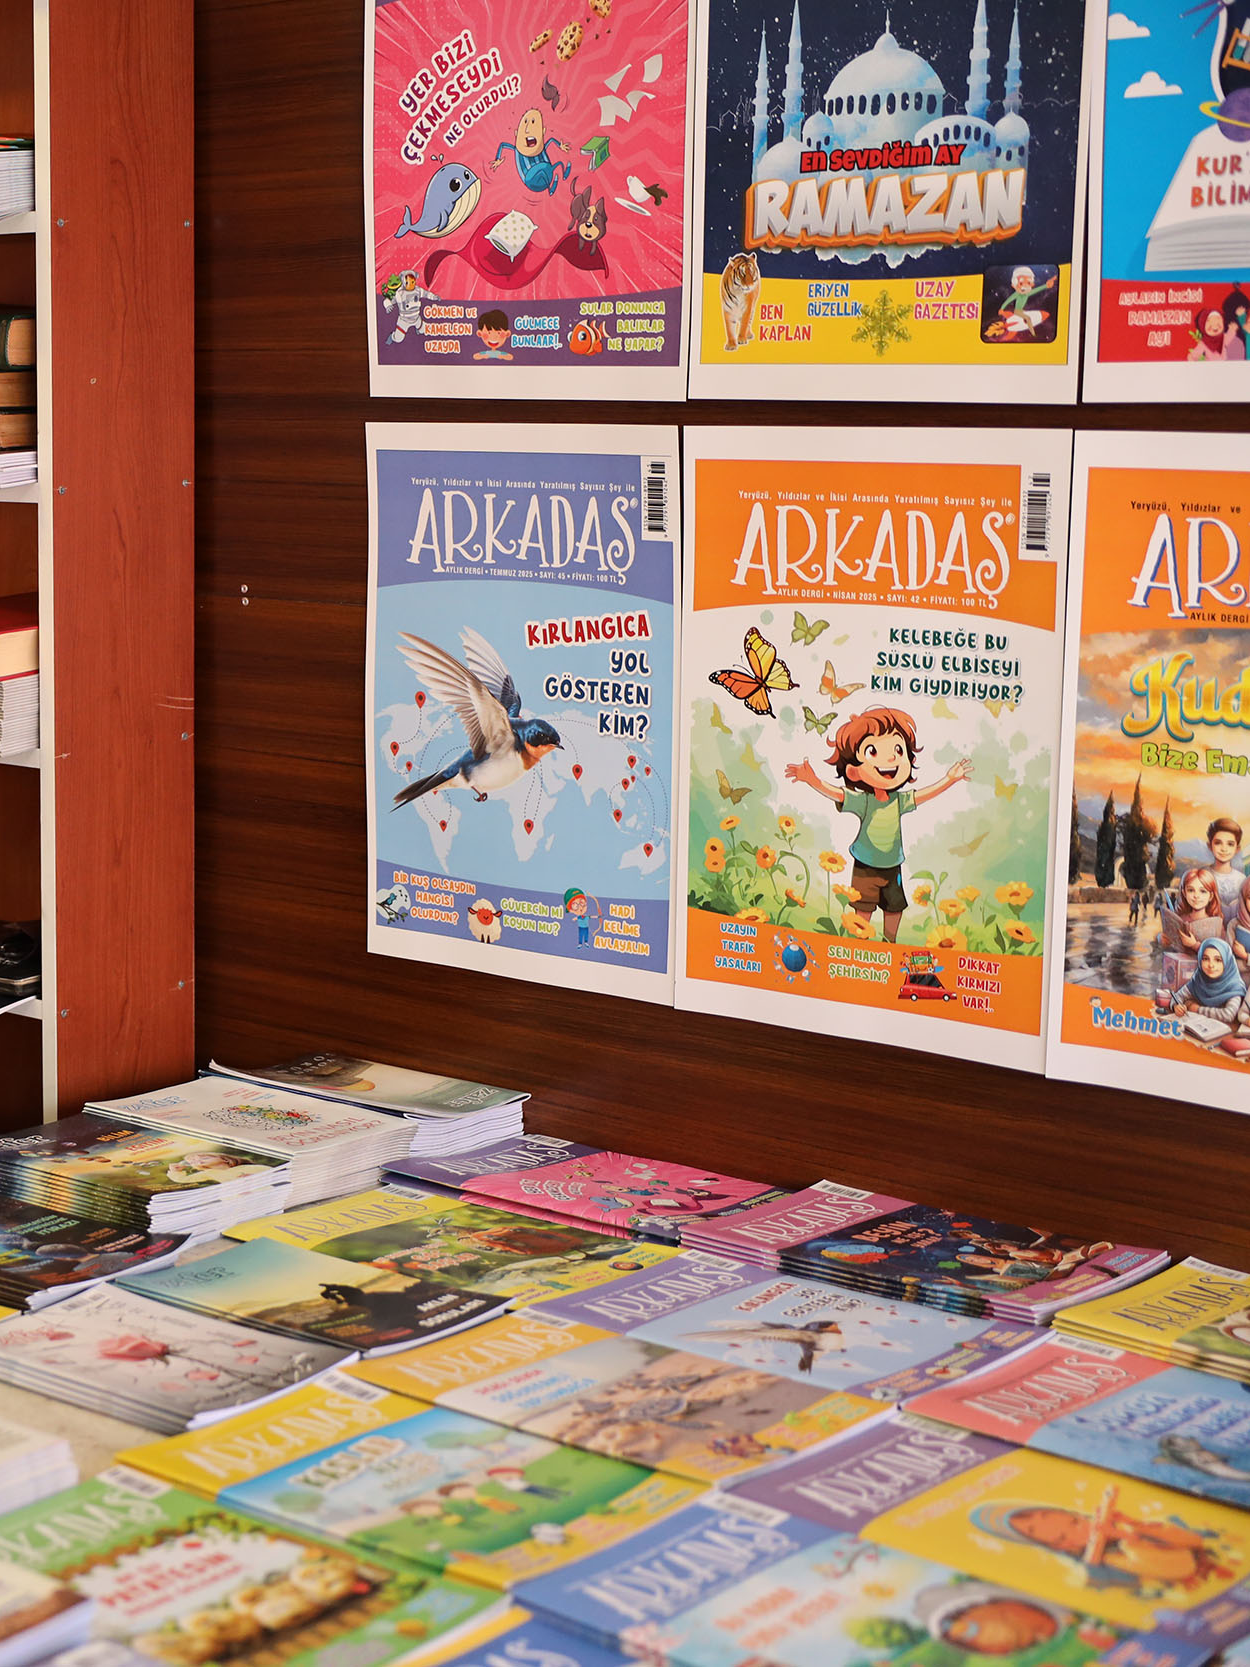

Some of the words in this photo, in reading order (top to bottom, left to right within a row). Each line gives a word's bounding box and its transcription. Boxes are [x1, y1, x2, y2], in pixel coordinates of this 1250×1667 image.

[400, 74, 434, 114] YER
[433, 31, 477, 75] BİZİ
[402, 50, 503, 162] ÇEKMESEYDİ
[444, 123, 464, 146] NE
[462, 75, 522, 125] OLURDU!?
[934, 143, 967, 166] AY
[746, 169, 1026, 249] RAMAZAN
[808, 283, 849, 298] ERİYEN
[915, 281, 956, 297] UZAY
[423, 304, 464, 319] GÖKMEN
[465, 306, 478, 319] VE
[579, 302, 614, 316] SULAR
[615, 301, 666, 316] DONUNCA
[760, 304, 784, 320] BEN
[807, 301, 862, 317] GÜZELLİK
[914, 302, 979, 320] GAZETESİ
[616, 319, 665, 333] BALIKLAR
[1128, 310, 1192, 326] RAMAZAN
[424, 322, 473, 336] KAMELEON
[759, 325, 811, 341] KAPLAN
[424, 340, 461, 353] UZAYDA
[607, 338, 623, 351] NE
[624, 337, 664, 352] YAPAR?
[1147, 331, 1172, 347] AYI
[443, 477, 471, 487] Yıldızlar
[777, 491, 810, 502] Yıldızlar
[816, 494, 825, 502] ve
[853, 493, 889, 503] Arasında
[1180, 502, 1221, 513] Yıldızlar
[406, 487, 637, 585] ARKADAŞ
[730, 501, 1011, 610] ARKADAŞ
[445, 566, 463, 575] AYLIK
[490, 568, 517, 578] TEMMUZ
[518, 569, 533, 578] 2025
[557, 572, 566, 580] 45
[597, 573, 608, 583] 100
[610, 574, 617, 583] TL
[1126, 513, 1250, 619] AR
[778, 588, 799, 598] AYLIK
[801, 587, 824, 599] DERGİ
[833, 589, 856, 600] NİSAN
[859, 591, 877, 601] 2025
[887, 593, 908, 603] SAYI:
[910, 594, 920, 603] 42
[961, 597, 975, 607] 100
[978, 598, 987, 607] TL
[1190, 611, 1216, 622] AYLIK
[1220, 612, 1249, 624] DERGİ
[889, 627, 977, 649] KELEBEĞE
[984, 634, 1008, 651] BU
[611, 650, 649, 674] YOL
[877, 649, 935, 670] SÜSLÜ
[941, 655, 1020, 677] ELBİSEYİ
[544, 673, 649, 706] GÖSTEREN
[870, 673, 902, 692] KİM
[909, 678, 1024, 704] GİYDİRİYOR?
[599, 711, 649, 740] KİM?
[1141, 742, 1199, 771] Bize
[1206, 748, 1250, 777] Em
[393, 870, 408, 884] BİR
[410, 874, 429, 889] KUŞ
[431, 878, 476, 895] OLSAYDIN
[415, 891, 454, 907] HANGİSİ
[500, 898, 548, 917] GÜVERCİN
[550, 904, 564, 918] Mİ
[410, 907, 459, 924] OLURDUN?
[609, 904, 636, 918] HADİ
[502, 915, 536, 931] KOYUN
[537, 921, 561, 936] MU?
[603, 921, 640, 937] KELİME
[720, 922, 757, 937] UZAYIN
[593, 936, 650, 956] AVLAYALIM
[721, 940, 755, 954] TRAFİK
[827, 945, 852, 960] SEN
[854, 949, 892, 965] HANGİ
[715, 956, 762, 973] YASALARI
[827, 963, 890, 984] ŞEHİRSİN?
[958, 956, 1001, 976] DİKKAT
[956, 976, 1001, 994] KIRMIZI
[1093, 1005, 1183, 1037] Mehmet
[730, 1195, 884, 1245] ARKADAŞ
